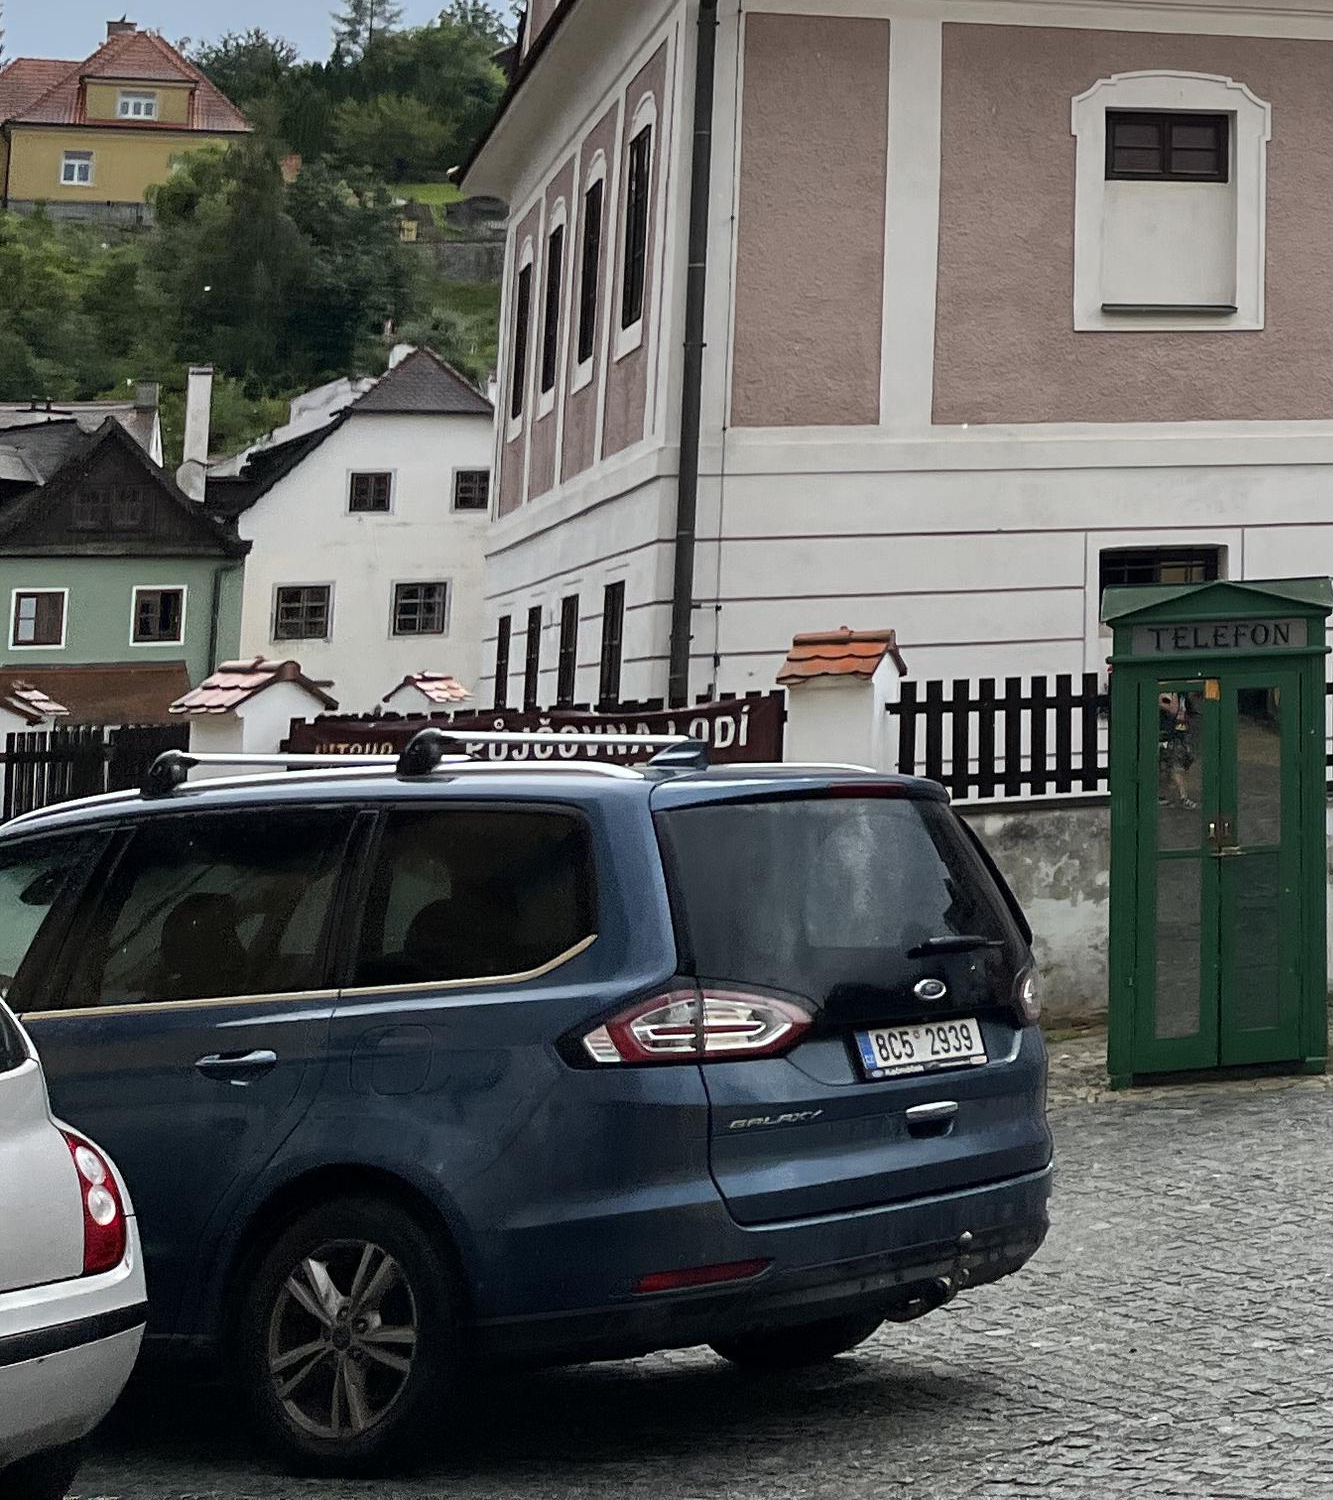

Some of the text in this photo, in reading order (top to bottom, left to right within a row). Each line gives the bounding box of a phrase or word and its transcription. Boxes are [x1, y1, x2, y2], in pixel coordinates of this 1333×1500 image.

[1148, 623, 1291, 652] TELEFON
[875, 1023, 974, 1062] 8C5 2939
